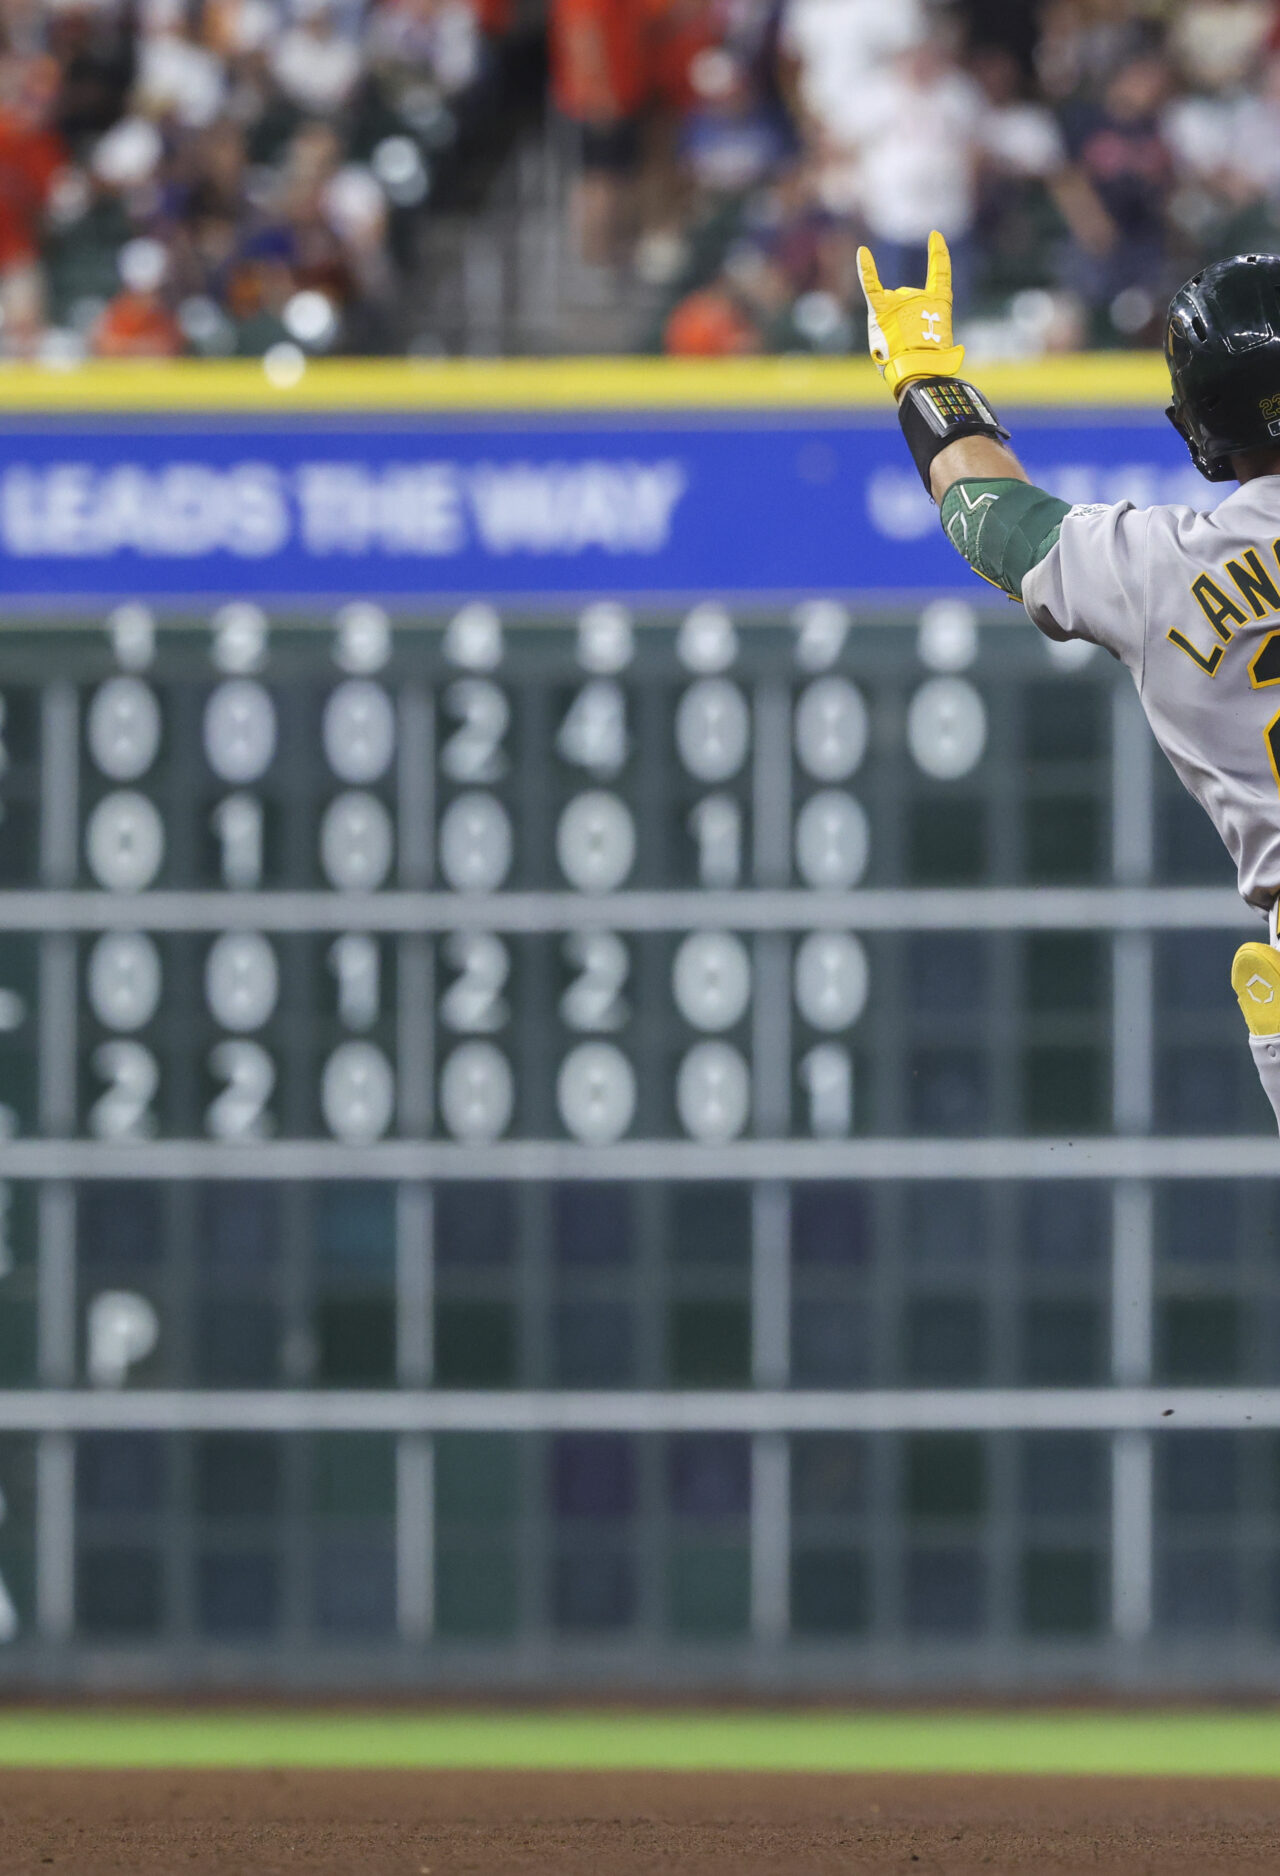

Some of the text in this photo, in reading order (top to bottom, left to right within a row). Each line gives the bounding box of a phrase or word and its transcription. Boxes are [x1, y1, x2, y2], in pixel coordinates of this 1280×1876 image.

[3, 459, 686, 558] LEADS THE WAY
[88, 675, 987, 782] 0 0 0 2 4 0 0 0
[86, 790, 869, 891] 0 1 0 0 0 1 0
[87, 930, 161, 1032] 0
[206, 930, 278, 1032] 0
[328, 930, 379, 1032] 1
[441, 930, 510, 1032] 2
[560, 930, 629, 1032] 2
[672, 930, 751, 1032] 0
[795, 930, 869, 1032] 0
[89, 1039, 852, 1142] 2 2 0 0 0 0 1
[87, 1290, 159, 1388] P
